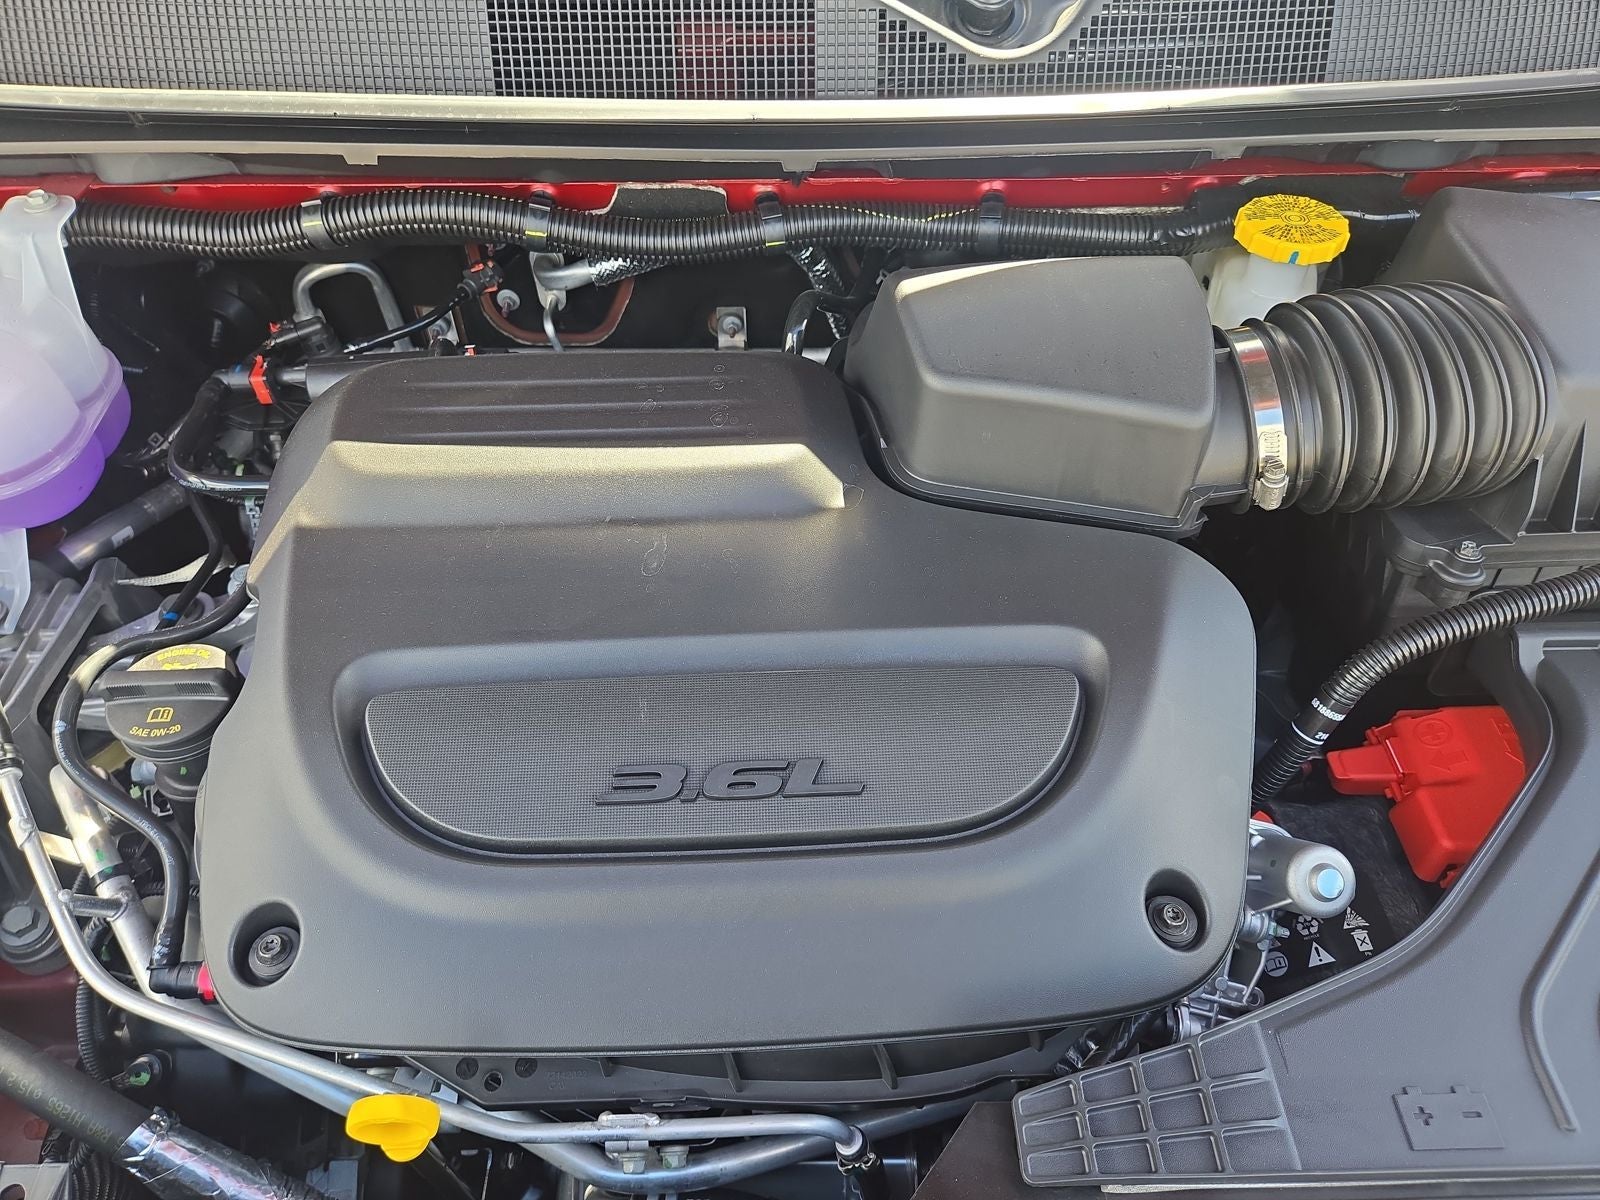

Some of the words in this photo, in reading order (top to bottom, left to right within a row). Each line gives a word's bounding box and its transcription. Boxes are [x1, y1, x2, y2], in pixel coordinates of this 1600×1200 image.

[156, 648, 196, 661] ENGINE
[129, 726, 151, 737] SAE
[150, 724, 182, 738] 0W-20
[595, 757, 866, 806] 3.6L
